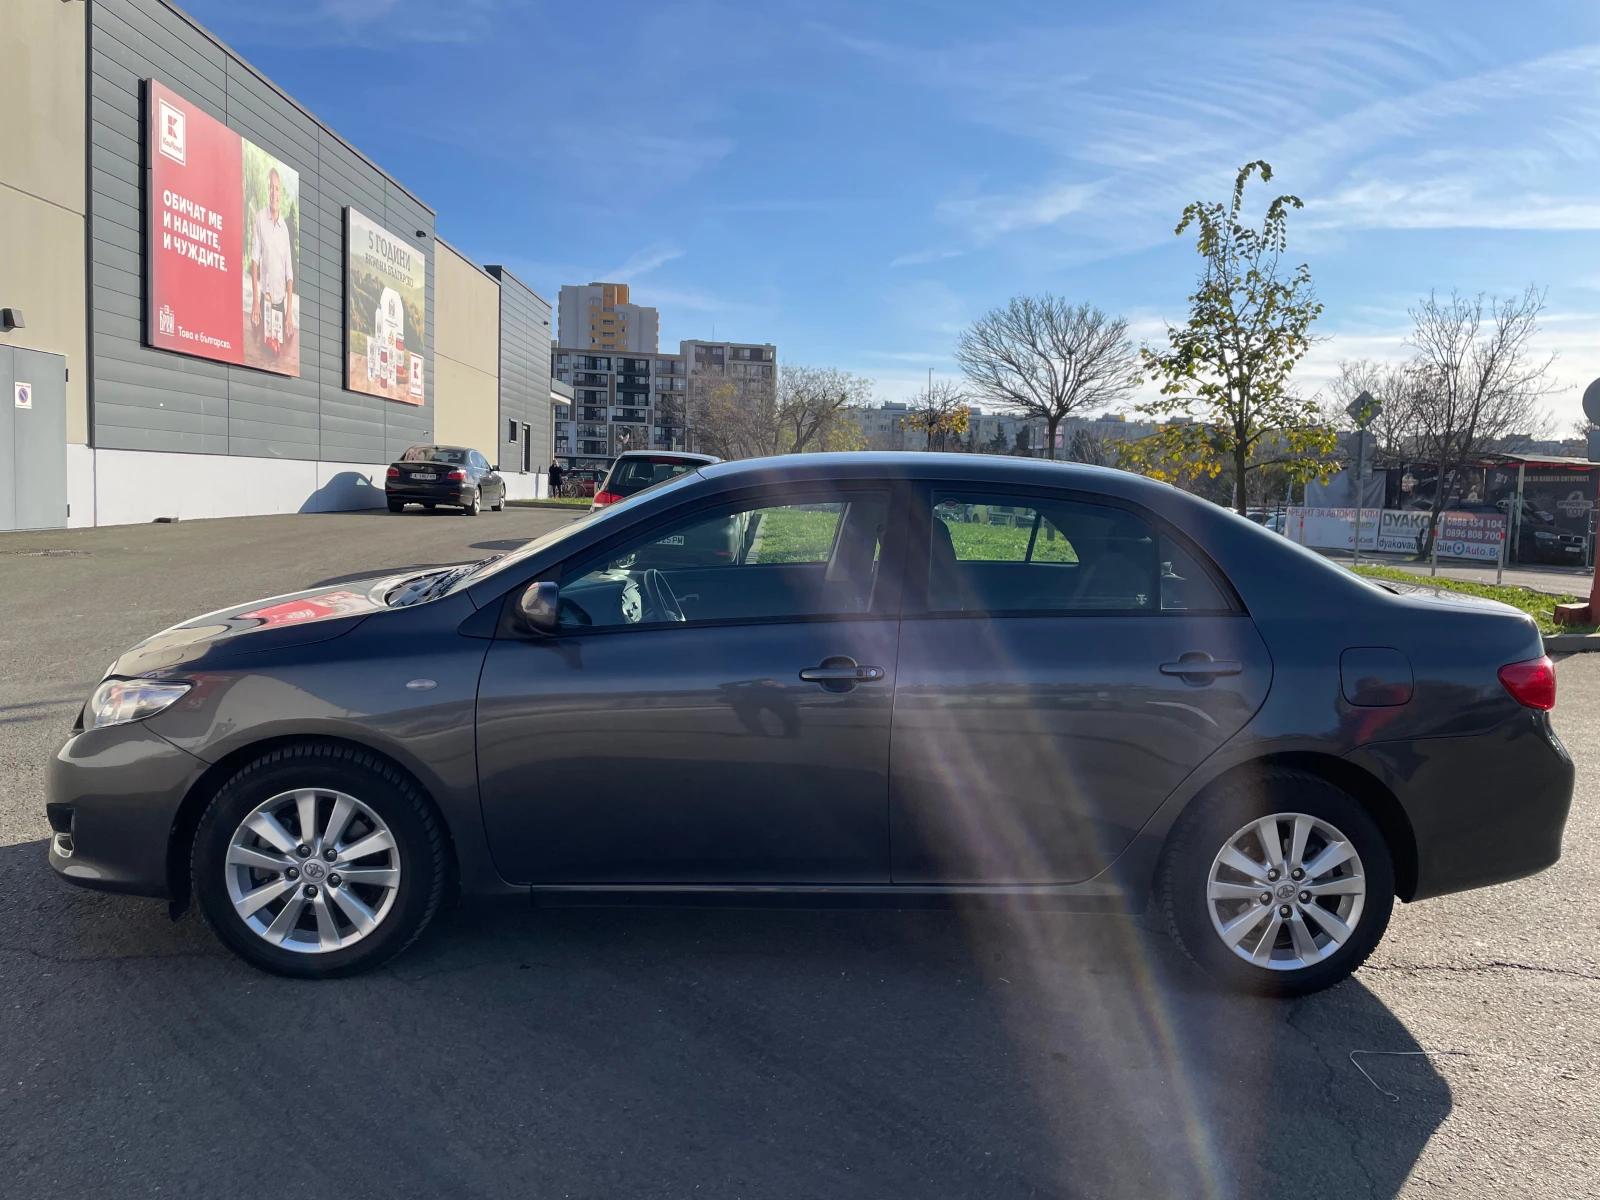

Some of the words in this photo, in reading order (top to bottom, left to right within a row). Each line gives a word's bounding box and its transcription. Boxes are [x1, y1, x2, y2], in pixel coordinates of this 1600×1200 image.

[162, 136, 183, 154] Kaufland
[163, 189, 206, 223] ОБИЧАТ
[208, 210, 223, 231] МЕ
[163, 210, 171, 229] И
[173, 215, 221, 252] НАШИТЕ,
[163, 232, 171, 250] И
[173, 236, 228, 272] ЧУЖДИТЕ.
[368, 229, 374, 250] 5
[375, 233, 411, 272] ГОДИНИ
[177, 325, 194, 340] Това
[194, 333, 199, 341] е
[1326, 508, 1379, 519] АВТОМОИЛИ
[1447, 517, 1467, 527] 0888
[1469, 518, 1484, 528] 454
[1486, 519, 1502, 529] 104
[1445, 528, 1466, 538] 0896
[1484, 530, 1501, 540] 700
